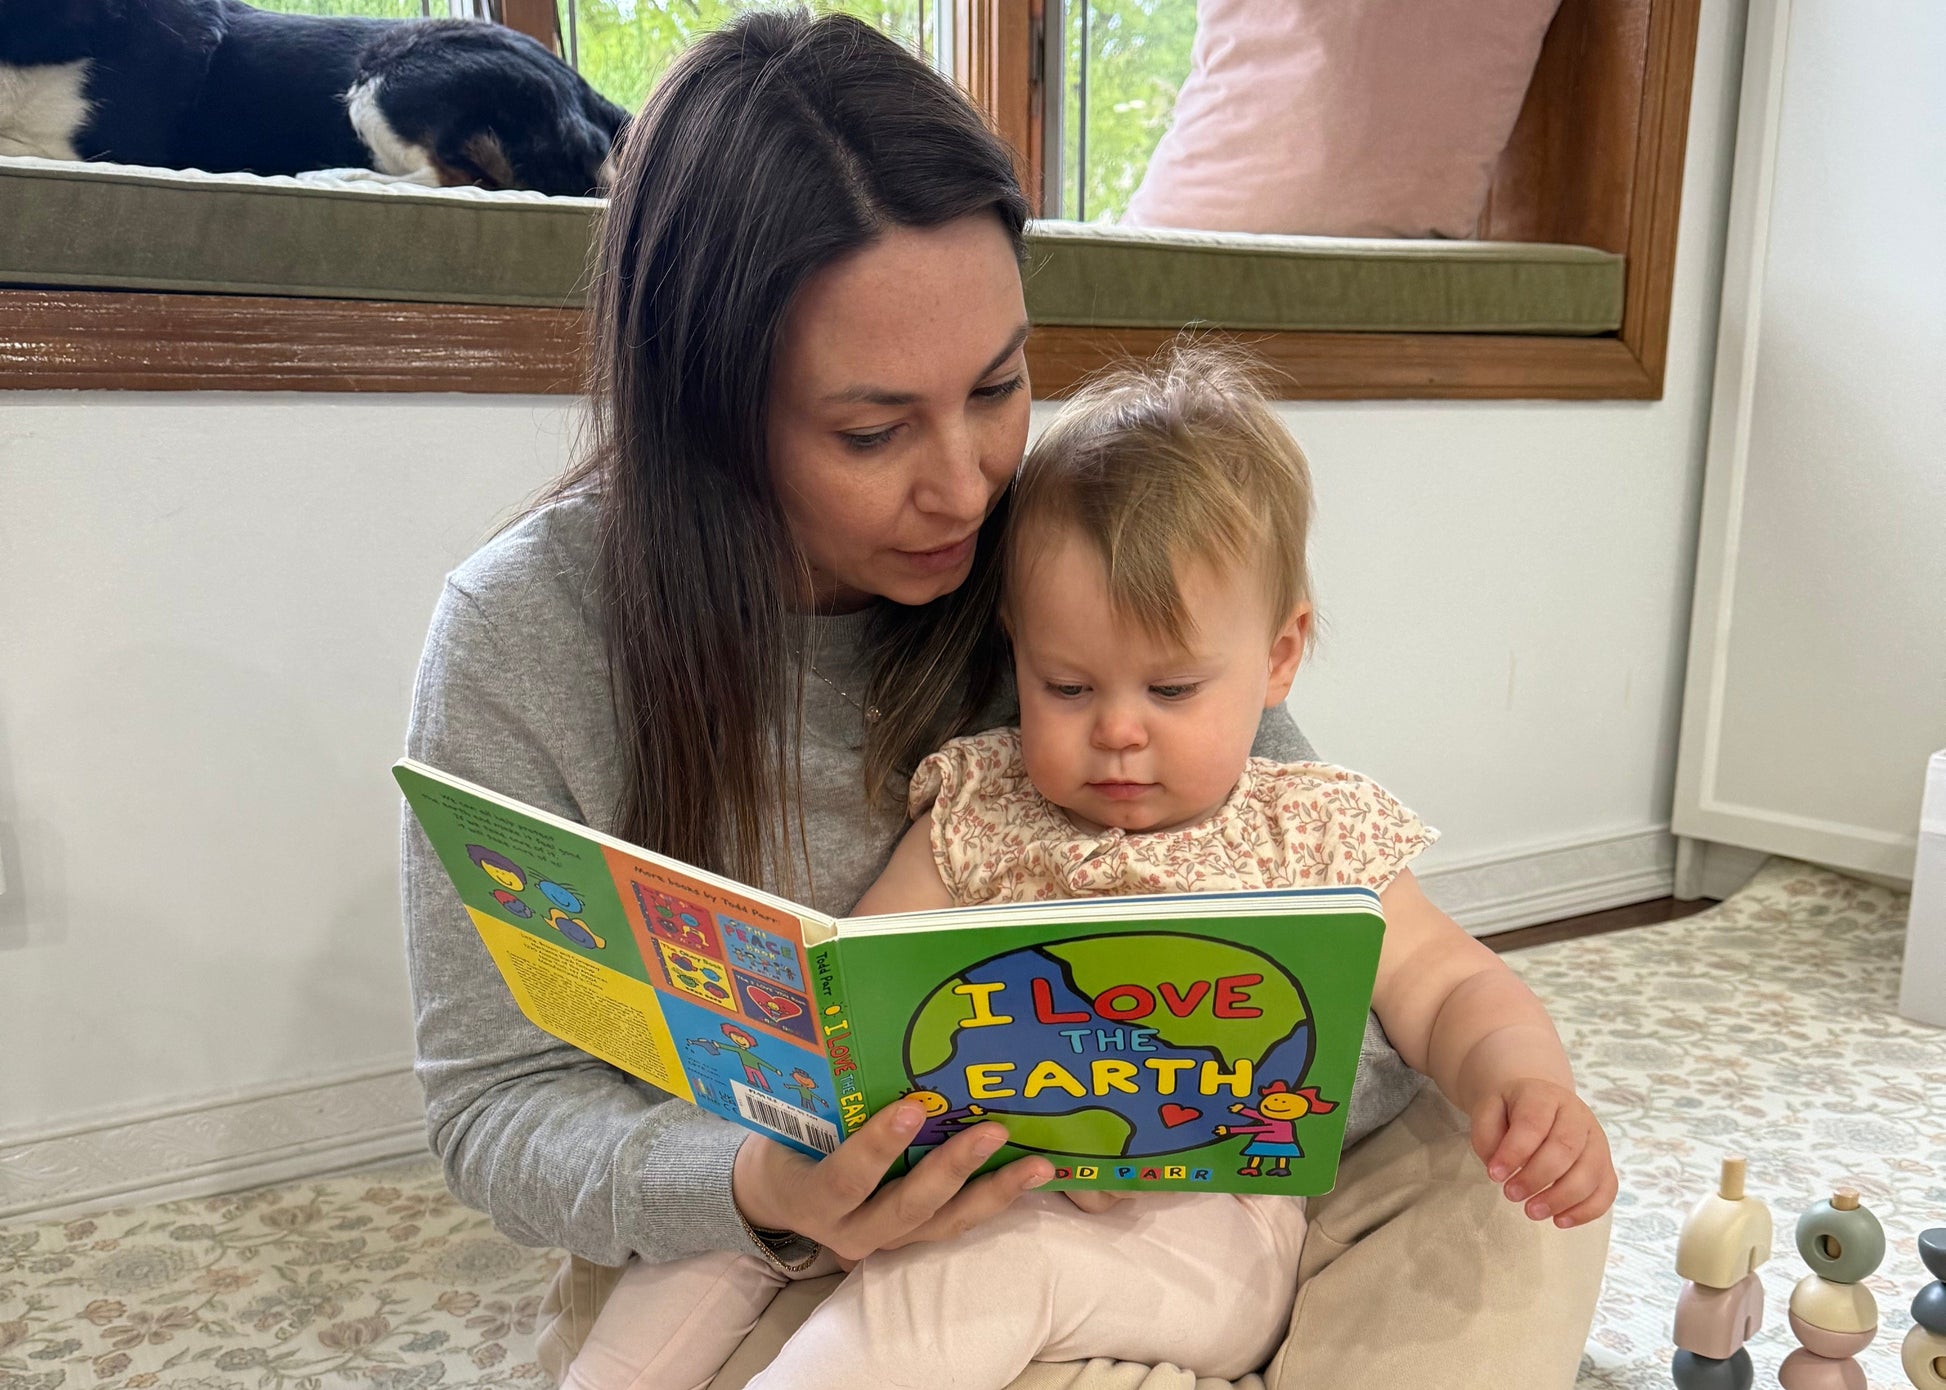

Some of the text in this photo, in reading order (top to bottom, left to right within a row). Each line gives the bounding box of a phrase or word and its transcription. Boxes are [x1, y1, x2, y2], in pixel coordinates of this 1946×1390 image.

[668, 878, 700, 895] books
[703, 890, 717, 903] by
[722, 897, 748, 913] Todd
[724, 924, 794, 961] PEACE
[816, 951, 834, 996] Todd Parr
[952, 973, 1264, 1028] I LOVE
[824, 1019, 849, 1036] I
[1059, 1027, 1160, 1053] THE
[826, 1031, 857, 1077] LOVE
[840, 1074, 856, 1095] THE
[964, 1057, 1255, 1100] EARTH
[1119, 1167, 1208, 1180] PARR
